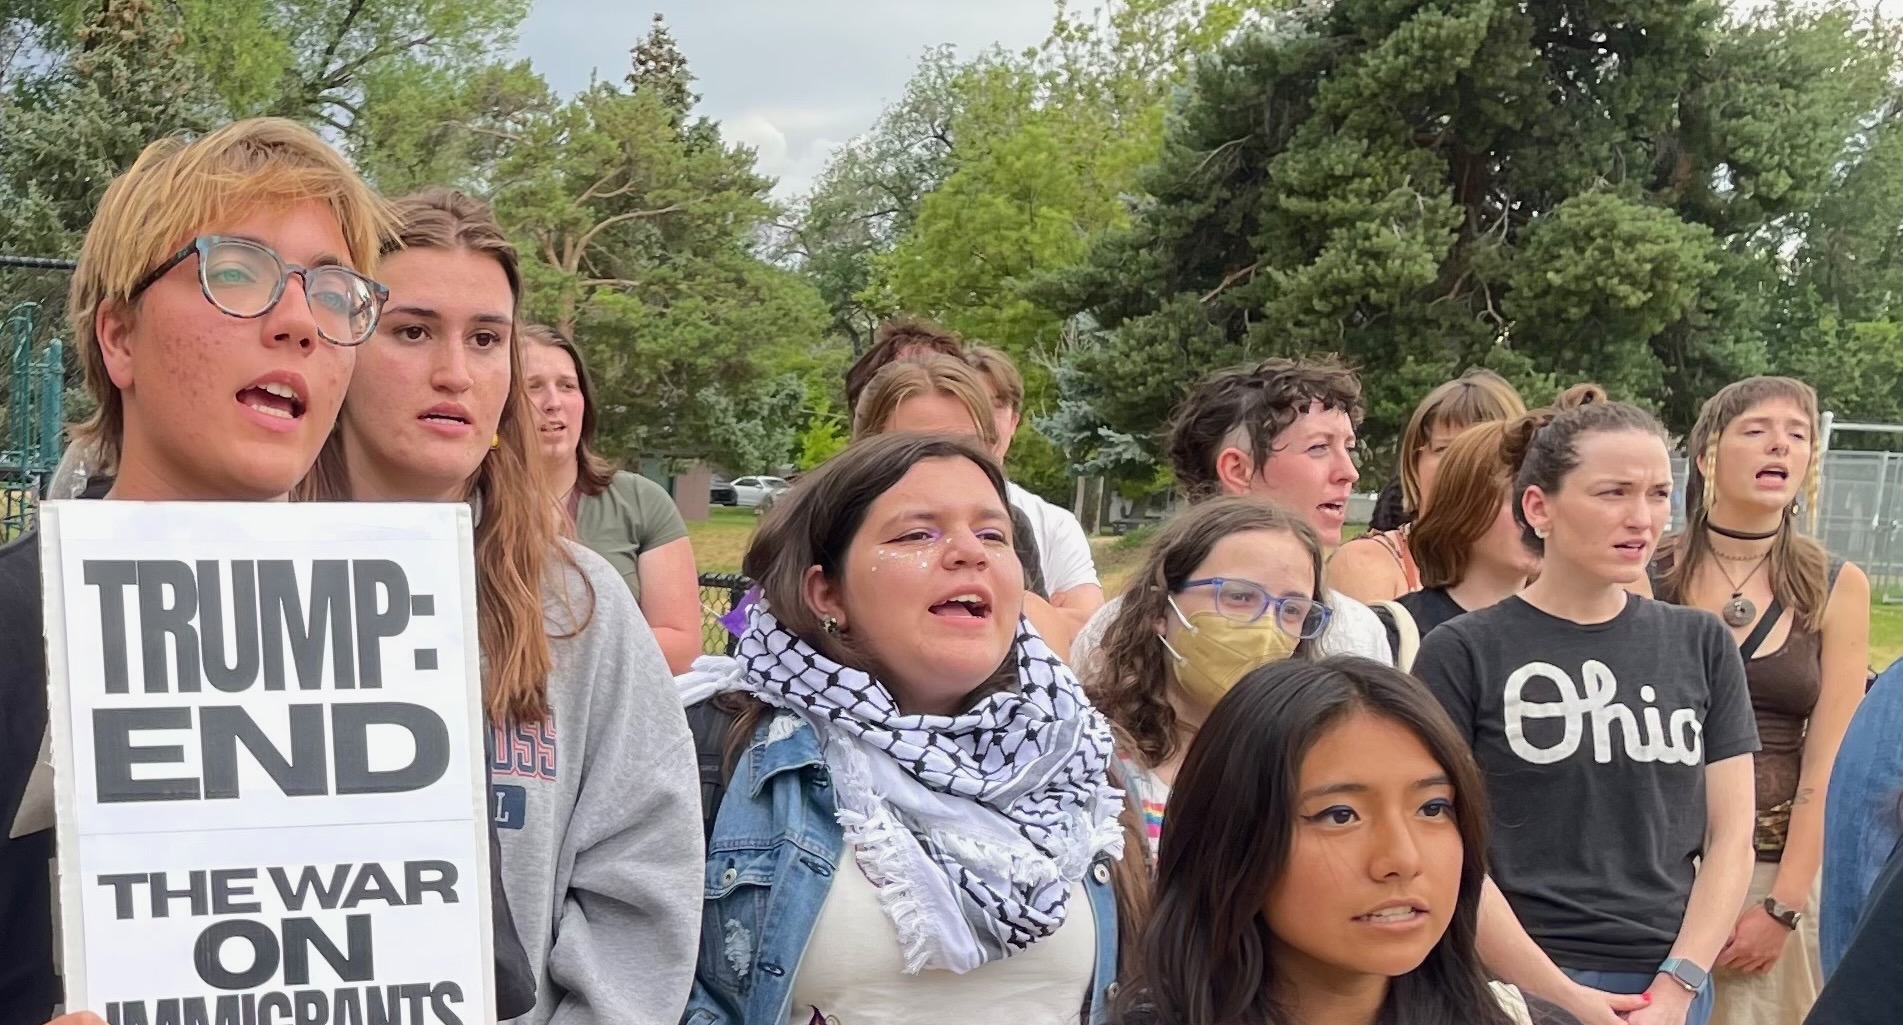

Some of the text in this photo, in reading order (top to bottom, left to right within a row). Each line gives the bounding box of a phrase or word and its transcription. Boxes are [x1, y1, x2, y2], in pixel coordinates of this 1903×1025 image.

[83, 560, 438, 694] TRUMP:
[92, 702, 450, 803] END
[1504, 660, 1702, 766] Ohio
[98, 868, 262, 920] THE
[267, 860, 459, 909] WAR
[192, 914, 375, 990] ON
